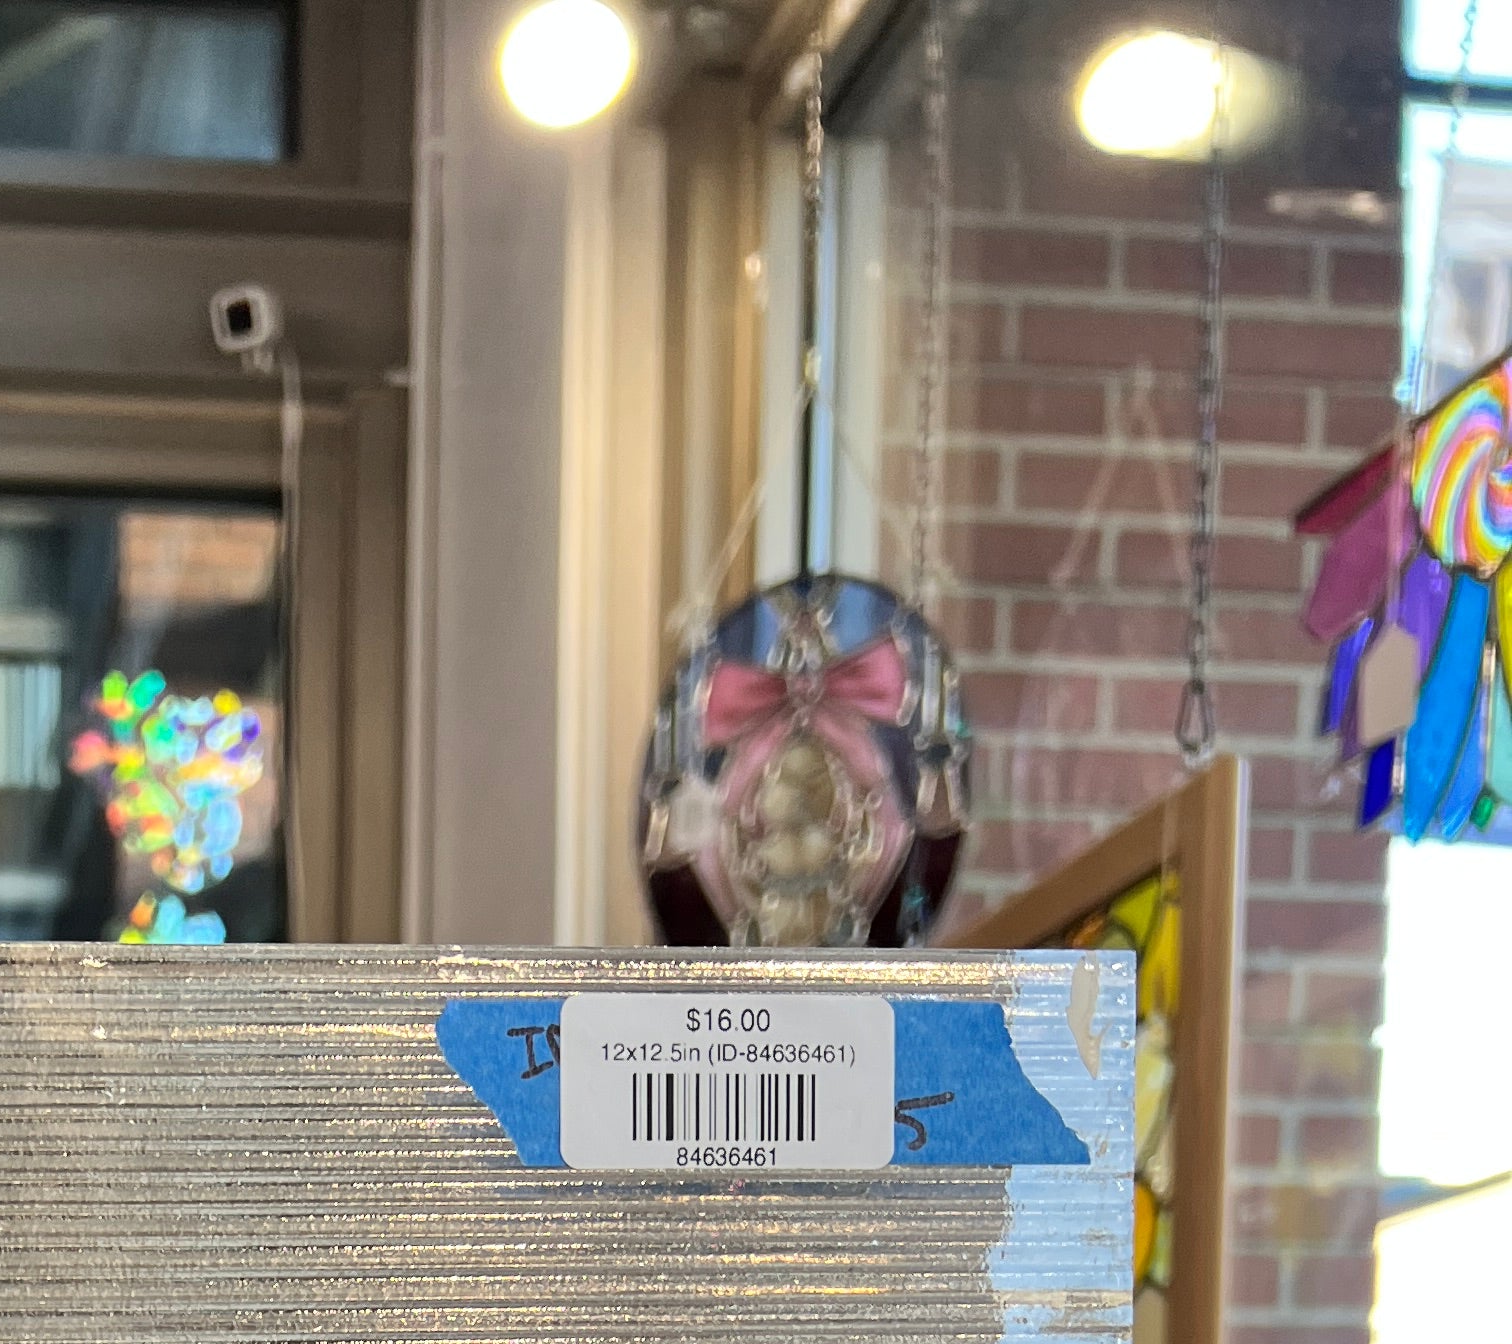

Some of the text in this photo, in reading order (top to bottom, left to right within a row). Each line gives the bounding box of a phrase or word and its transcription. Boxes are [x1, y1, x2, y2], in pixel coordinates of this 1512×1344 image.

[686, 1008, 771, 1033] $16.00
[601, 1043, 856, 1069] 12x12.5in (ID-84636461)
[676, 1147, 776, 1167] 84636461
